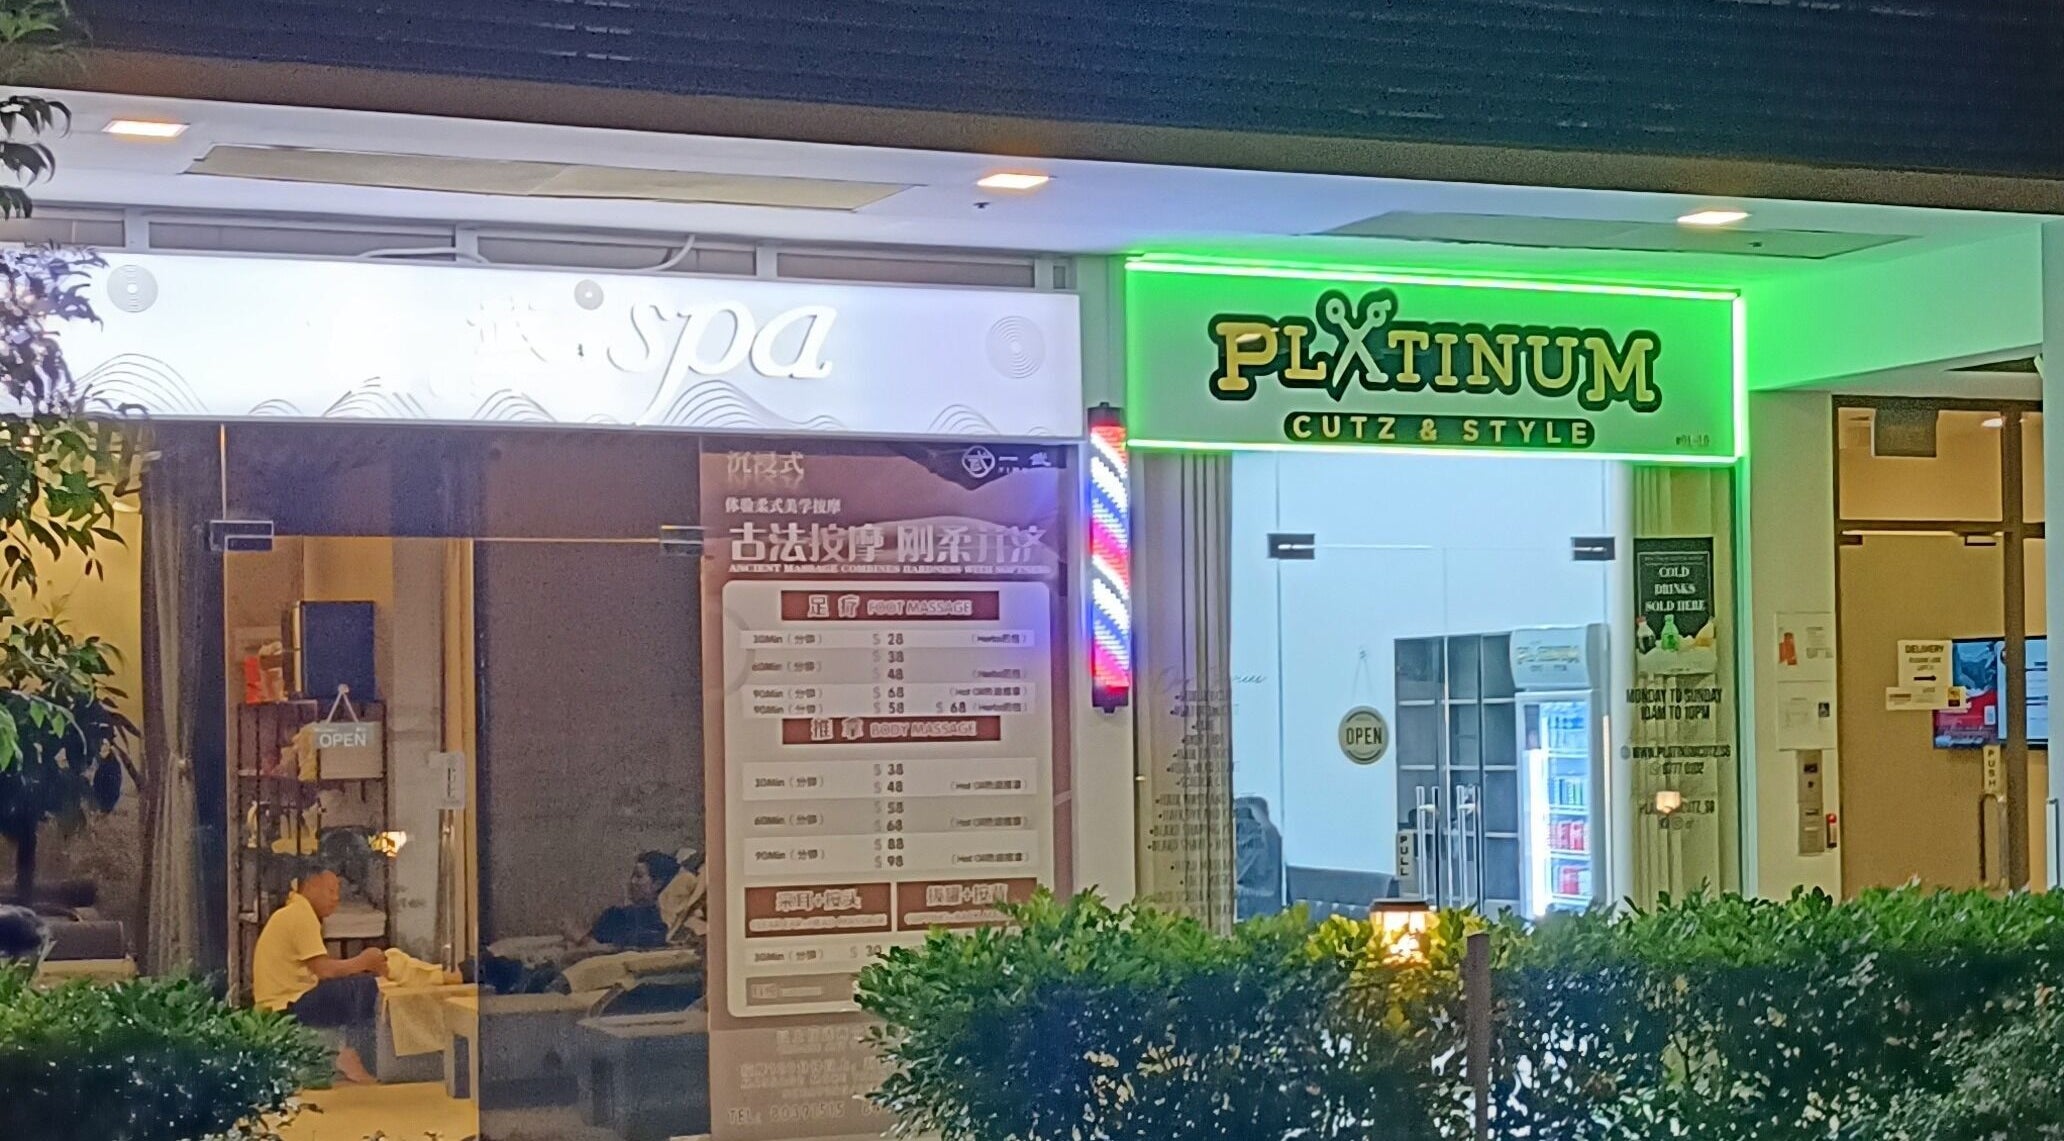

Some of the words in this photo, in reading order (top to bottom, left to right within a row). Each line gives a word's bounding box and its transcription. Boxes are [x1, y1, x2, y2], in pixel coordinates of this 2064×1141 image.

[607, 301, 839, 425] spa
[1292, 415, 1397, 440] CUTZ
[1420, 418, 1438, 442] &
[1462, 420, 1588, 444] STYLE
[728, 521, 885, 563] 古法按摩
[1658, 566, 1690, 578] COLD
[1654, 583, 1697, 595] DRINKS
[867, 600, 906, 616] FOOT
[906, 600, 973, 616] MASSAGE
[1644, 600, 1675, 612] SOLD
[1676, 599, 1706, 612] HERE
[887, 633, 904, 645] 28
[887, 651, 904, 663] 38
[887, 668, 904, 680] 48
[887, 687, 904, 698] 68
[1626, 688, 1667, 703] MONDAY
[1670, 688, 1683, 703] TO
[1683, 687, 1723, 703] SUNDAY
[887, 702, 904, 714] 58
[950, 702, 967, 713] 68
[1669, 705, 1682, 719] TO
[870, 722, 910, 738] BODY
[910, 721, 977, 737] MASSAGE
[1345, 727, 1383, 745] OPEN
[319, 733, 367, 748] OPEN
[887, 763, 904, 776] 38
[1987, 749, 1997, 787] PUSH
[887, 780, 904, 793] 48
[887, 801, 904, 814] 58
[886, 819, 903, 832] 68
[887, 838, 904, 850] 88
[887, 855, 904, 868] 98
[1399, 835, 1409, 876] PULL
